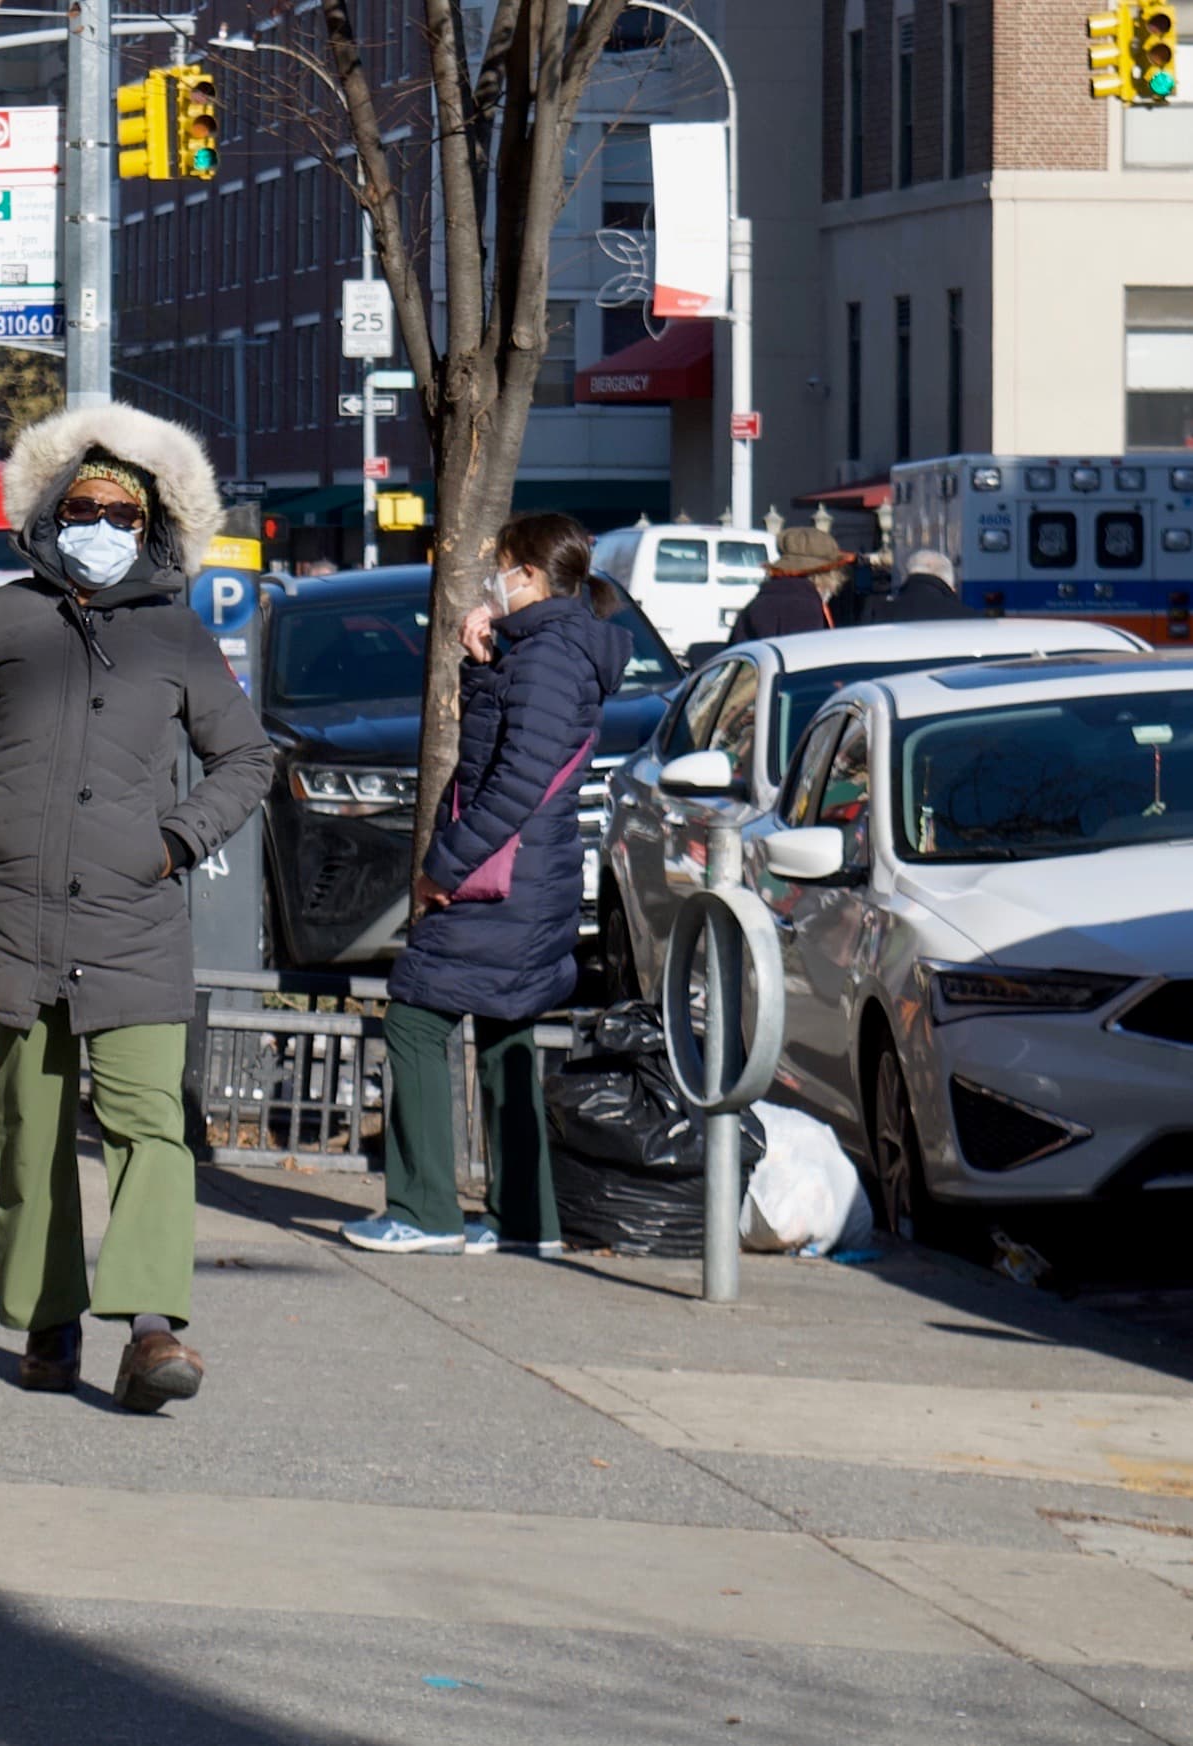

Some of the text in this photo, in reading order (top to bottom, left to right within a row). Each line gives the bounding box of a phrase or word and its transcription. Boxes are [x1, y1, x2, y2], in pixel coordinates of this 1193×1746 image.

[352, 312, 383, 331] 25
[590, 375, 649, 393] EMERGENCY
[212, 577, 244, 625] P
